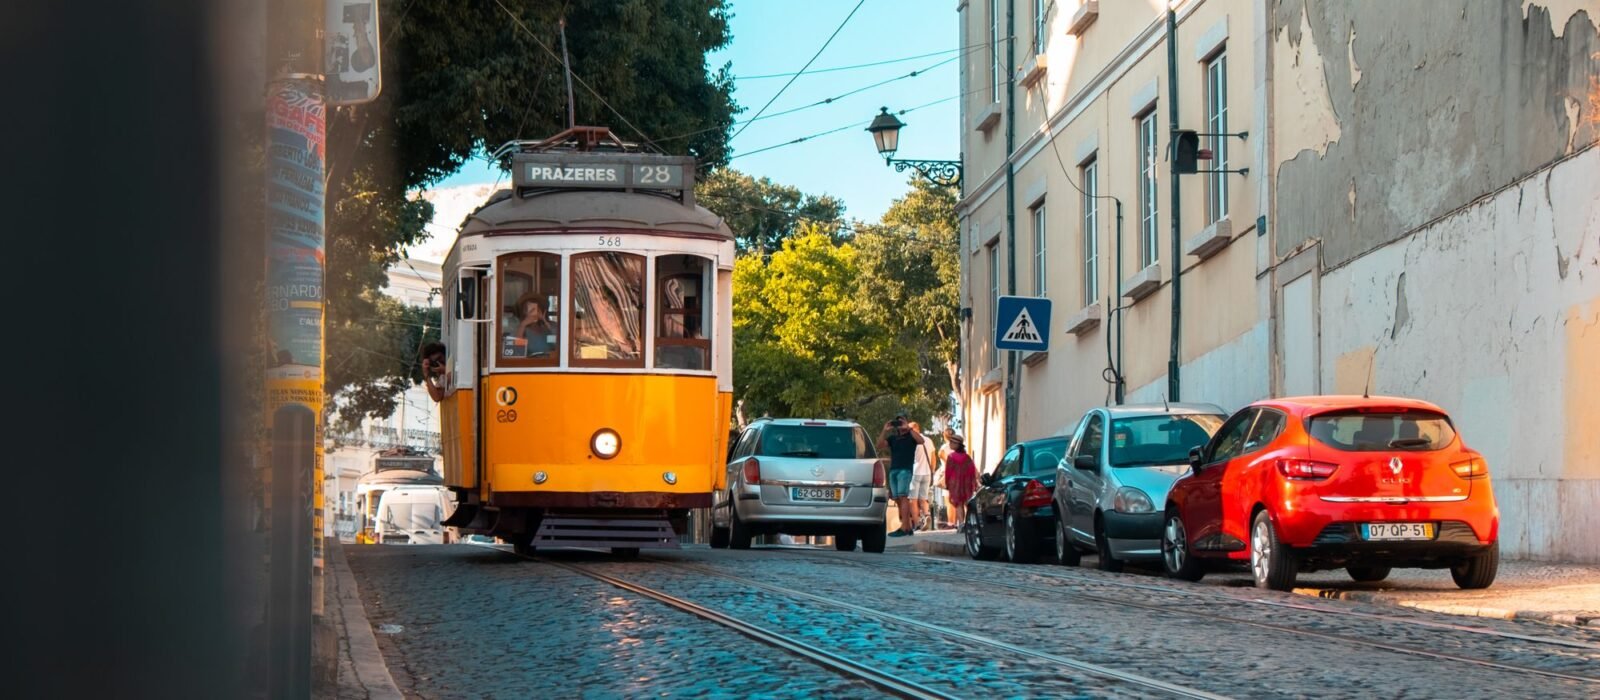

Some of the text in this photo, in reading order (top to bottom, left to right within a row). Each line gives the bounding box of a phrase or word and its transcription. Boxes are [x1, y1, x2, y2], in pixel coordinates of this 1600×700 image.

[531, 166, 671, 183] PRAZERES 28
[598, 236, 621, 247] 568
